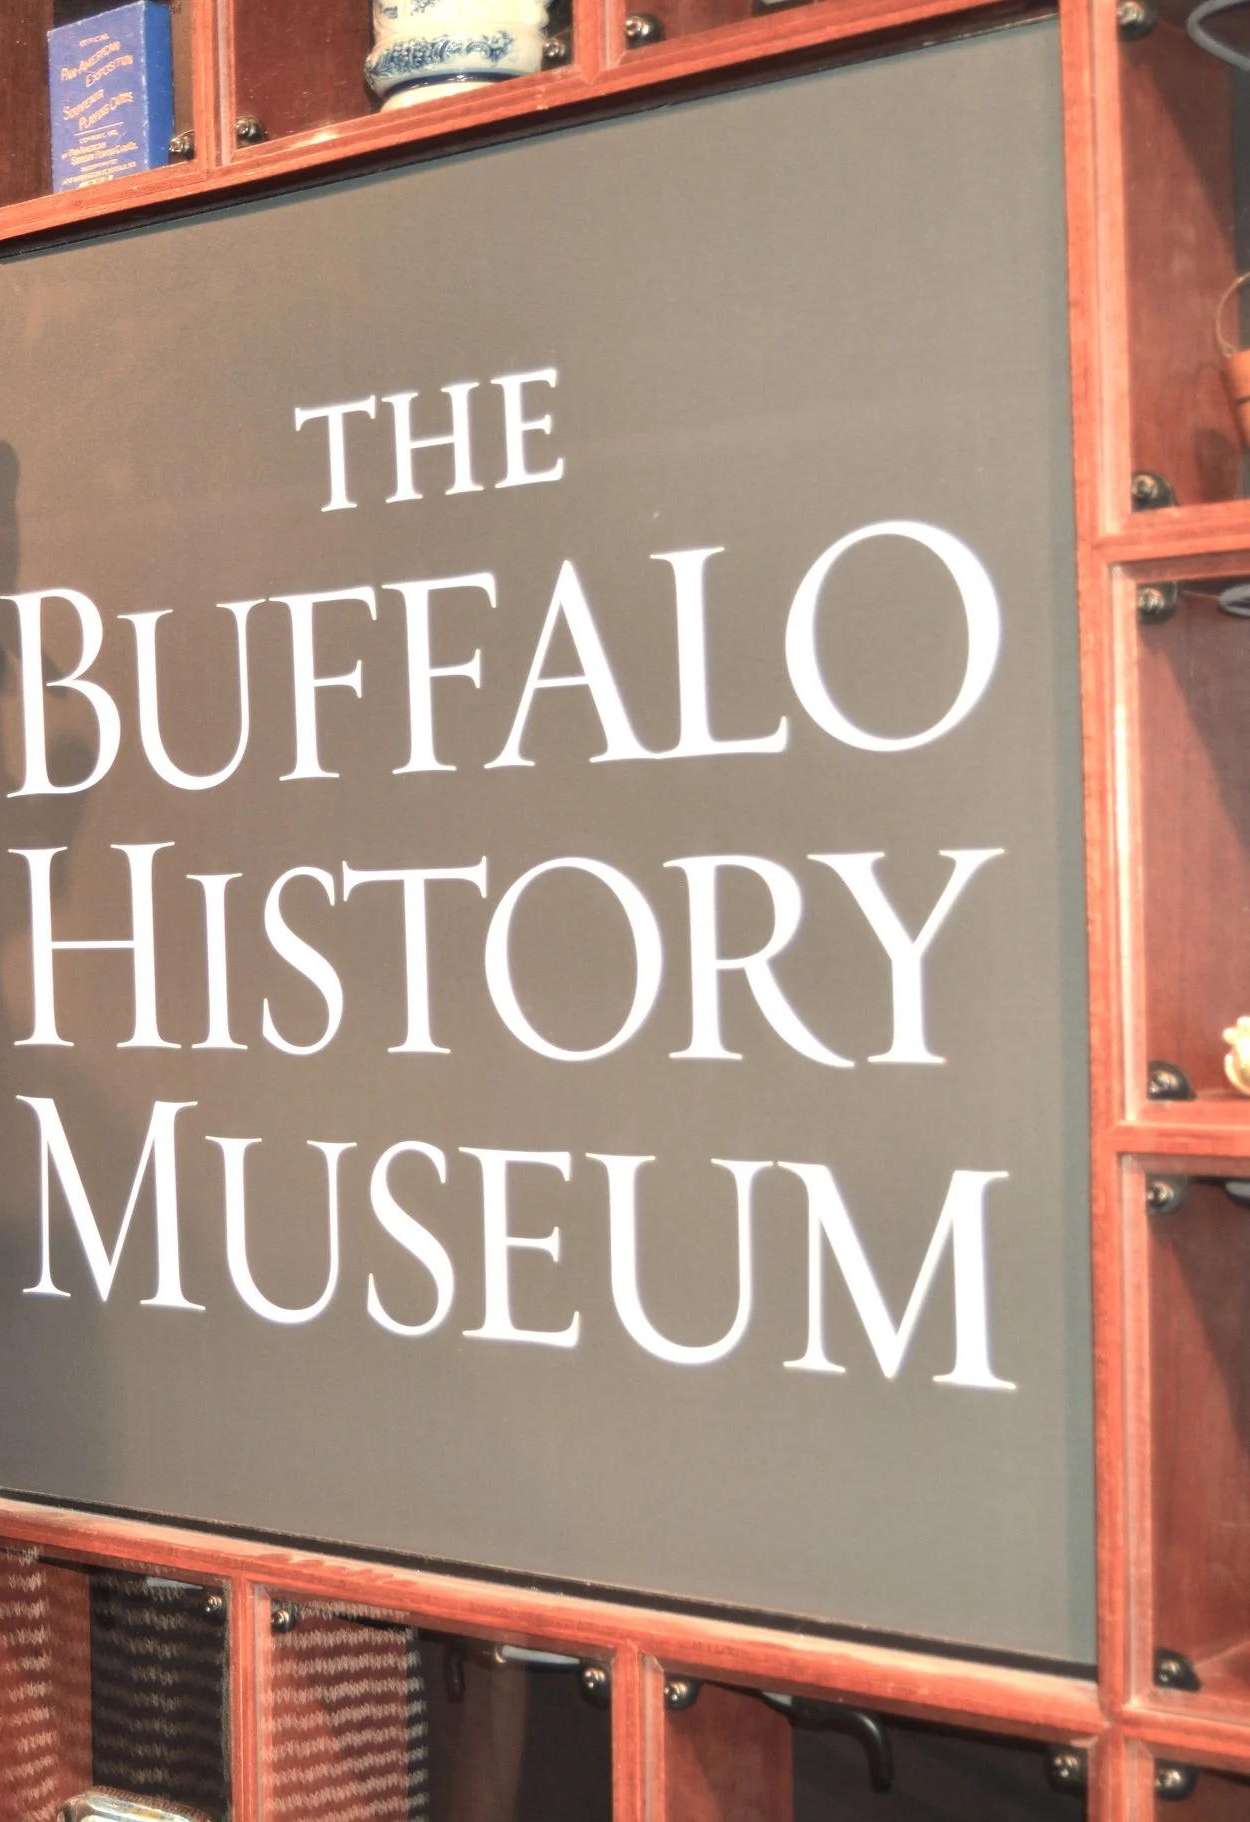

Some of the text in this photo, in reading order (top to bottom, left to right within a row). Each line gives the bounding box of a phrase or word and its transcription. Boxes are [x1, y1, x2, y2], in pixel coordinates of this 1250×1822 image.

[293, 367, 566, 513] THE
[7, 840, 1006, 1069] HISTORY
[15, 1094, 1017, 1391] MUSEUM
